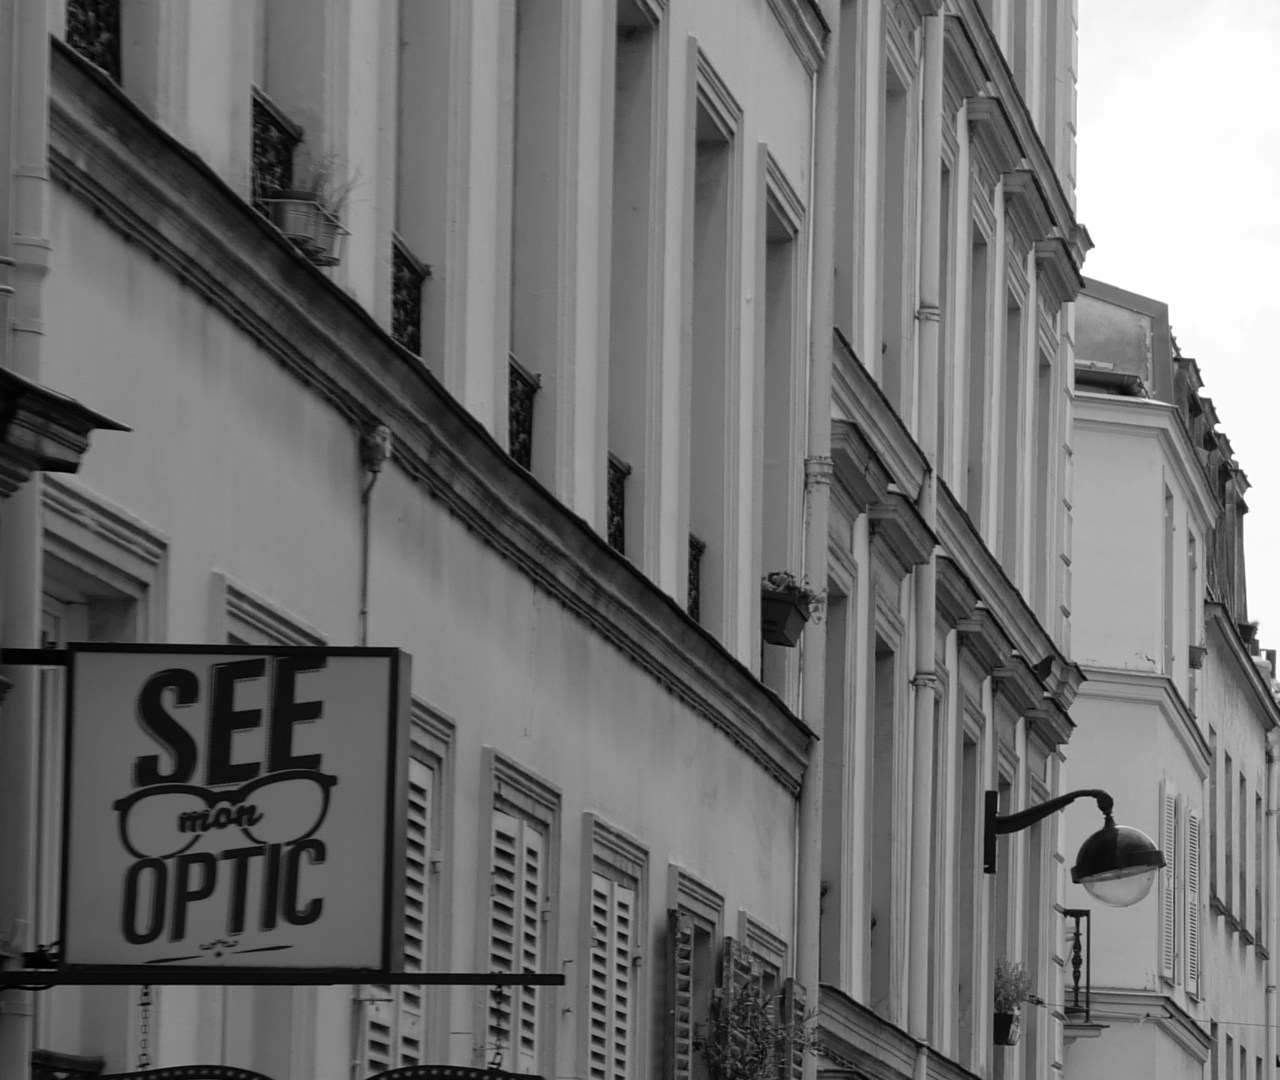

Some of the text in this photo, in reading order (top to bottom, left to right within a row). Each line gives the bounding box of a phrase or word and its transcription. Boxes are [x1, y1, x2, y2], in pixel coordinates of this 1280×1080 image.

[134, 656, 328, 787] SEE
[178, 802, 263, 834] mon
[120, 838, 328, 946] OPTIC
